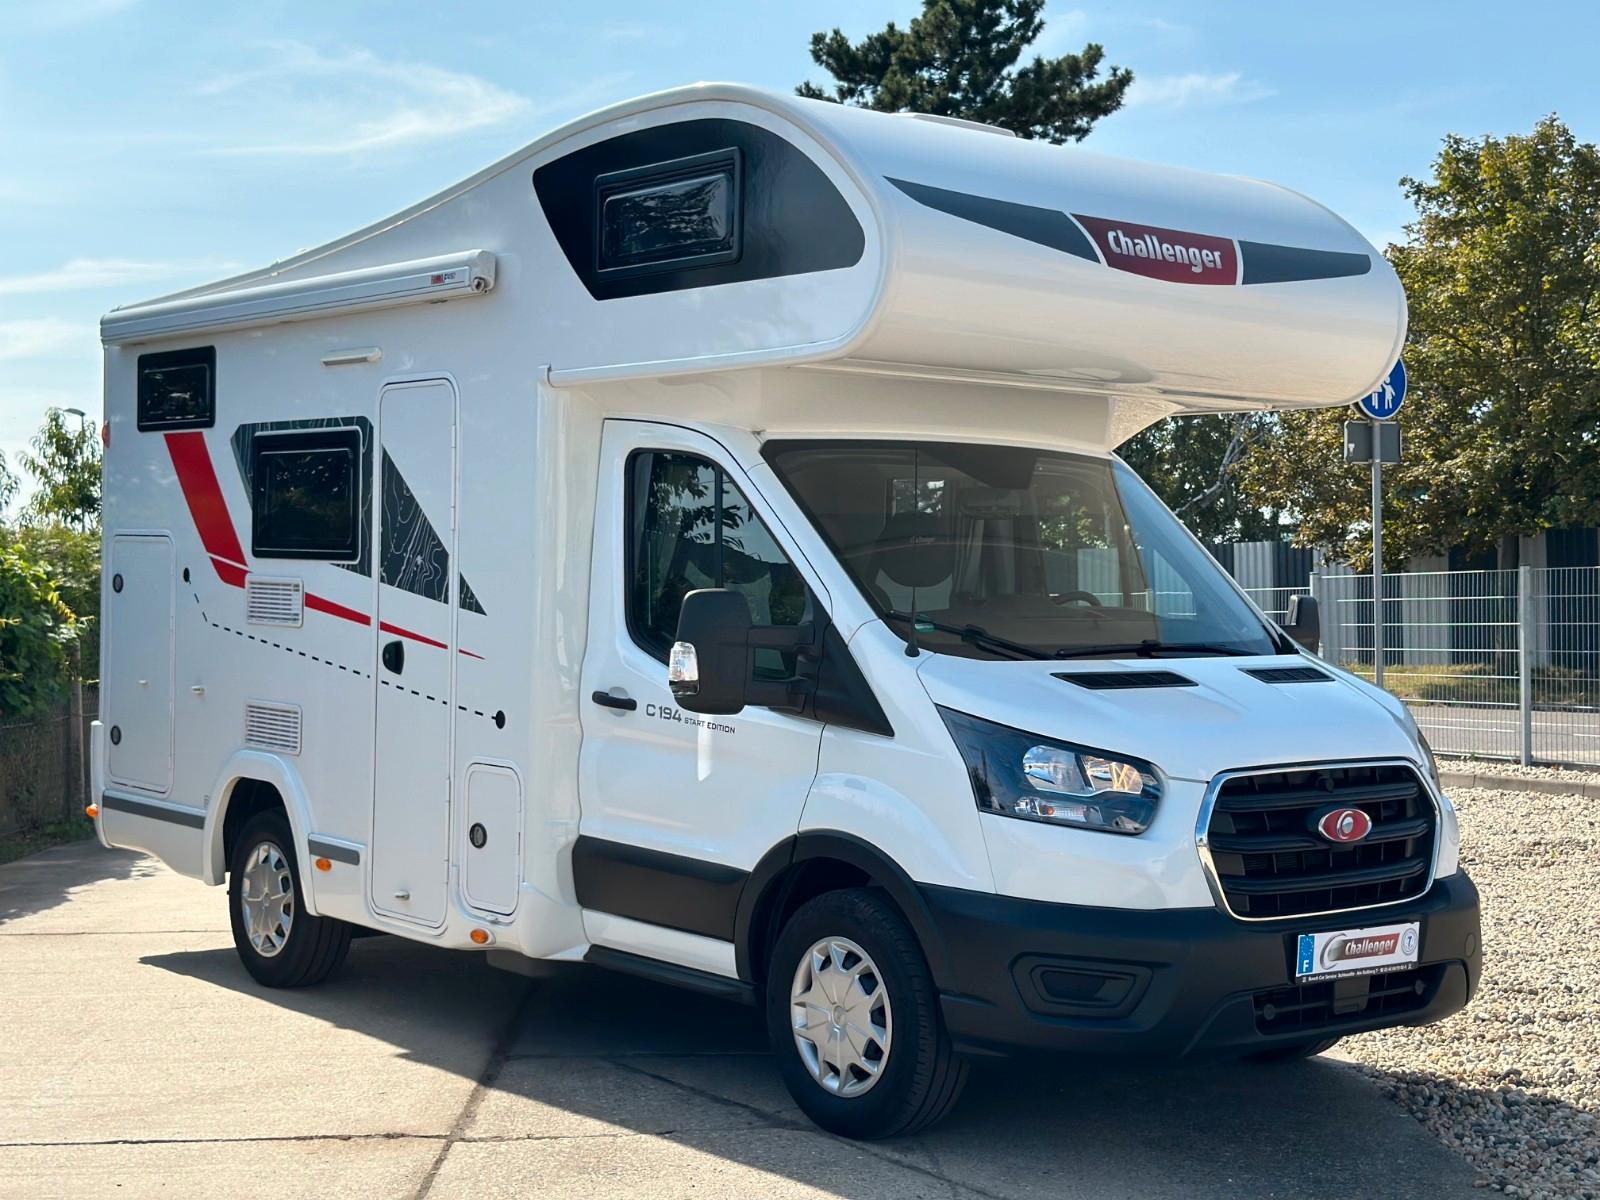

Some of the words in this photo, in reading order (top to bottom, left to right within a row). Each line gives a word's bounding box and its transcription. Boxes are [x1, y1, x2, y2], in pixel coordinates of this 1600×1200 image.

[1107, 229, 1222, 273] Challenger
[646, 703, 656, 717] C
[658, 705, 682, 723] 194
[684, 717, 705, 727] START
[706, 721, 736, 734] EDITION
[1345, 939, 1396, 956] Challenger
[1303, 960, 1310, 973] F
